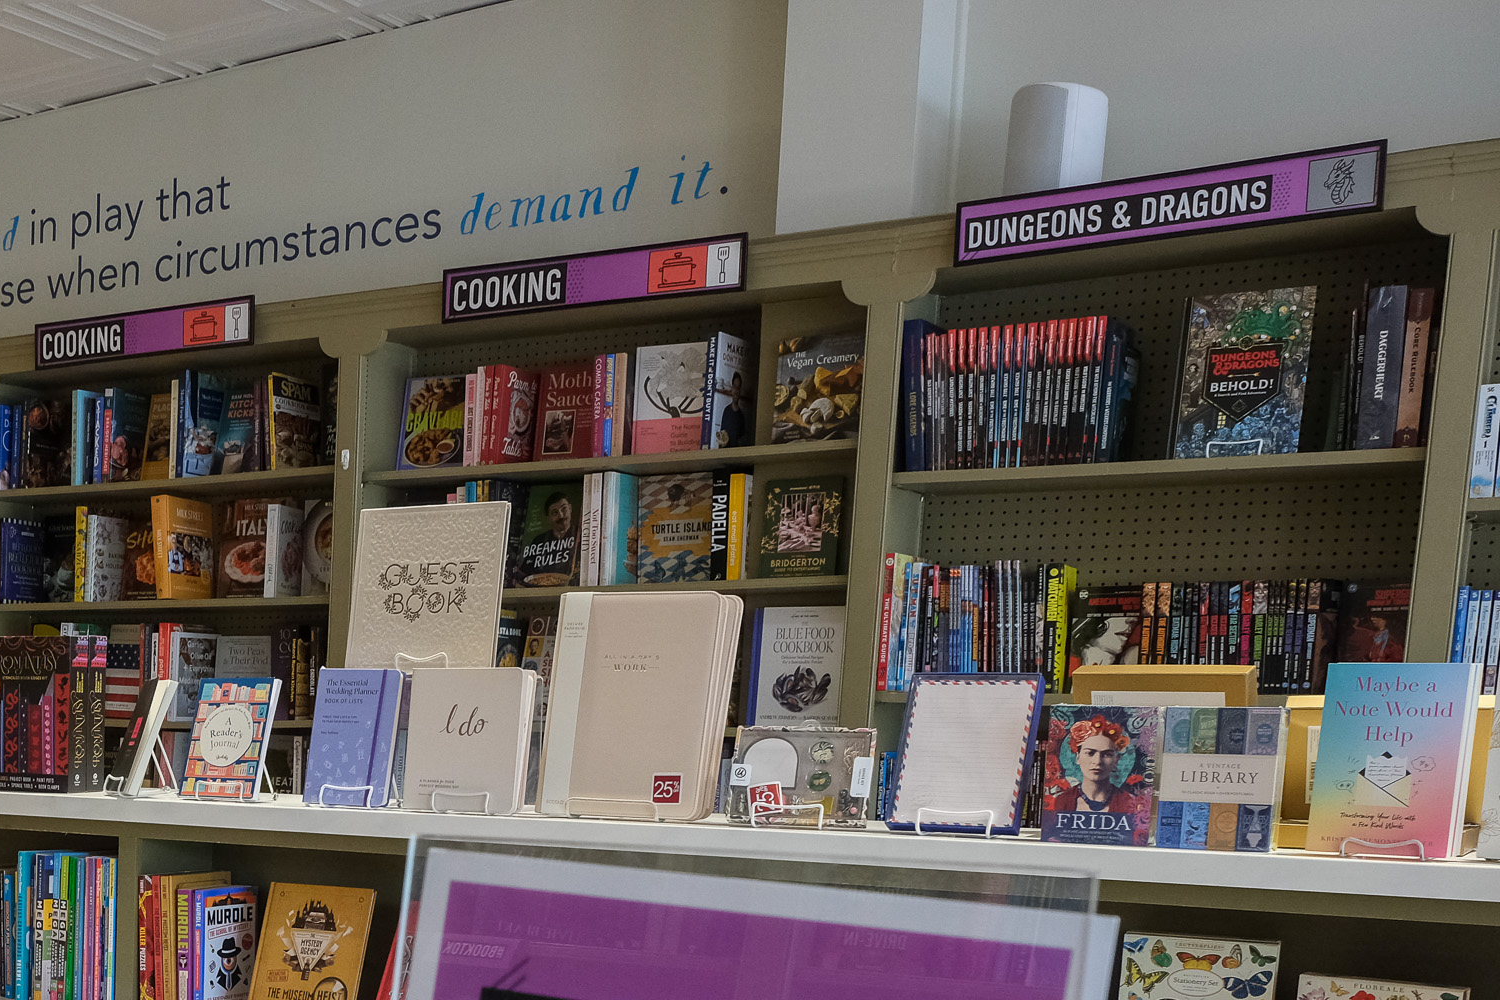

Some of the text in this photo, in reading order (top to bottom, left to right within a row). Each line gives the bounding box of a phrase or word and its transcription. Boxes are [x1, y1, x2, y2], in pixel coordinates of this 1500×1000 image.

[30, 209, 56, 245] in
[71, 193, 143, 249] play
[156, 176, 230, 221] that
[968, 180, 1267, 248] DUNGEONS & DRAGONS
[48, 255, 139, 299] when
[155, 207, 442, 283] circumstances
[458, 167, 640, 236] demand
[670, 155, 729, 206] it.
[452, 268, 562, 312] COOKING
[42, 325, 121, 361] COOKING
[787, 353, 859, 370] Vegan Creamery
[1211, 350, 1276, 364] DUNGEONS
[1374, 330, 1389, 400] DAGGERHEART
[281, 380, 312, 400] SPAM
[1209, 379, 1274, 393] BEHOLD!
[652, 523, 680, 534] TURTLE
[712, 494, 727, 553] PADELLA
[523, 537, 575, 558] BREAKING
[770, 557, 826, 568] BRIDGERTON
[381, 561, 479, 588] GUEST
[387, 589, 465, 617] BOOK
[1046, 578, 1059, 622] WATCHMEN
[775, 627, 835, 640] BLUE FOOD
[773, 640, 834, 653] COOKBOOK
[339, 678, 368, 686] Essential
[1355, 676, 1437, 697] Maybe a
[326, 687, 352, 696] Wedding
[1334, 701, 1453, 717] Note Would
[458, 706, 489, 736] do
[210, 728, 244, 739] Reader's
[1364, 726, 1413, 747] Help
[210, 740, 240, 751] Journal
[1181, 770, 1259, 784] LIBRARY
[1056, 813, 1131, 831] FRIDA
[207, 906, 253, 926] MURDLE
[1173, 977, 1219, 986] Stationery Set
[1353, 982, 1405, 993] FLOREALE
[267, 986, 280, 998] THE
